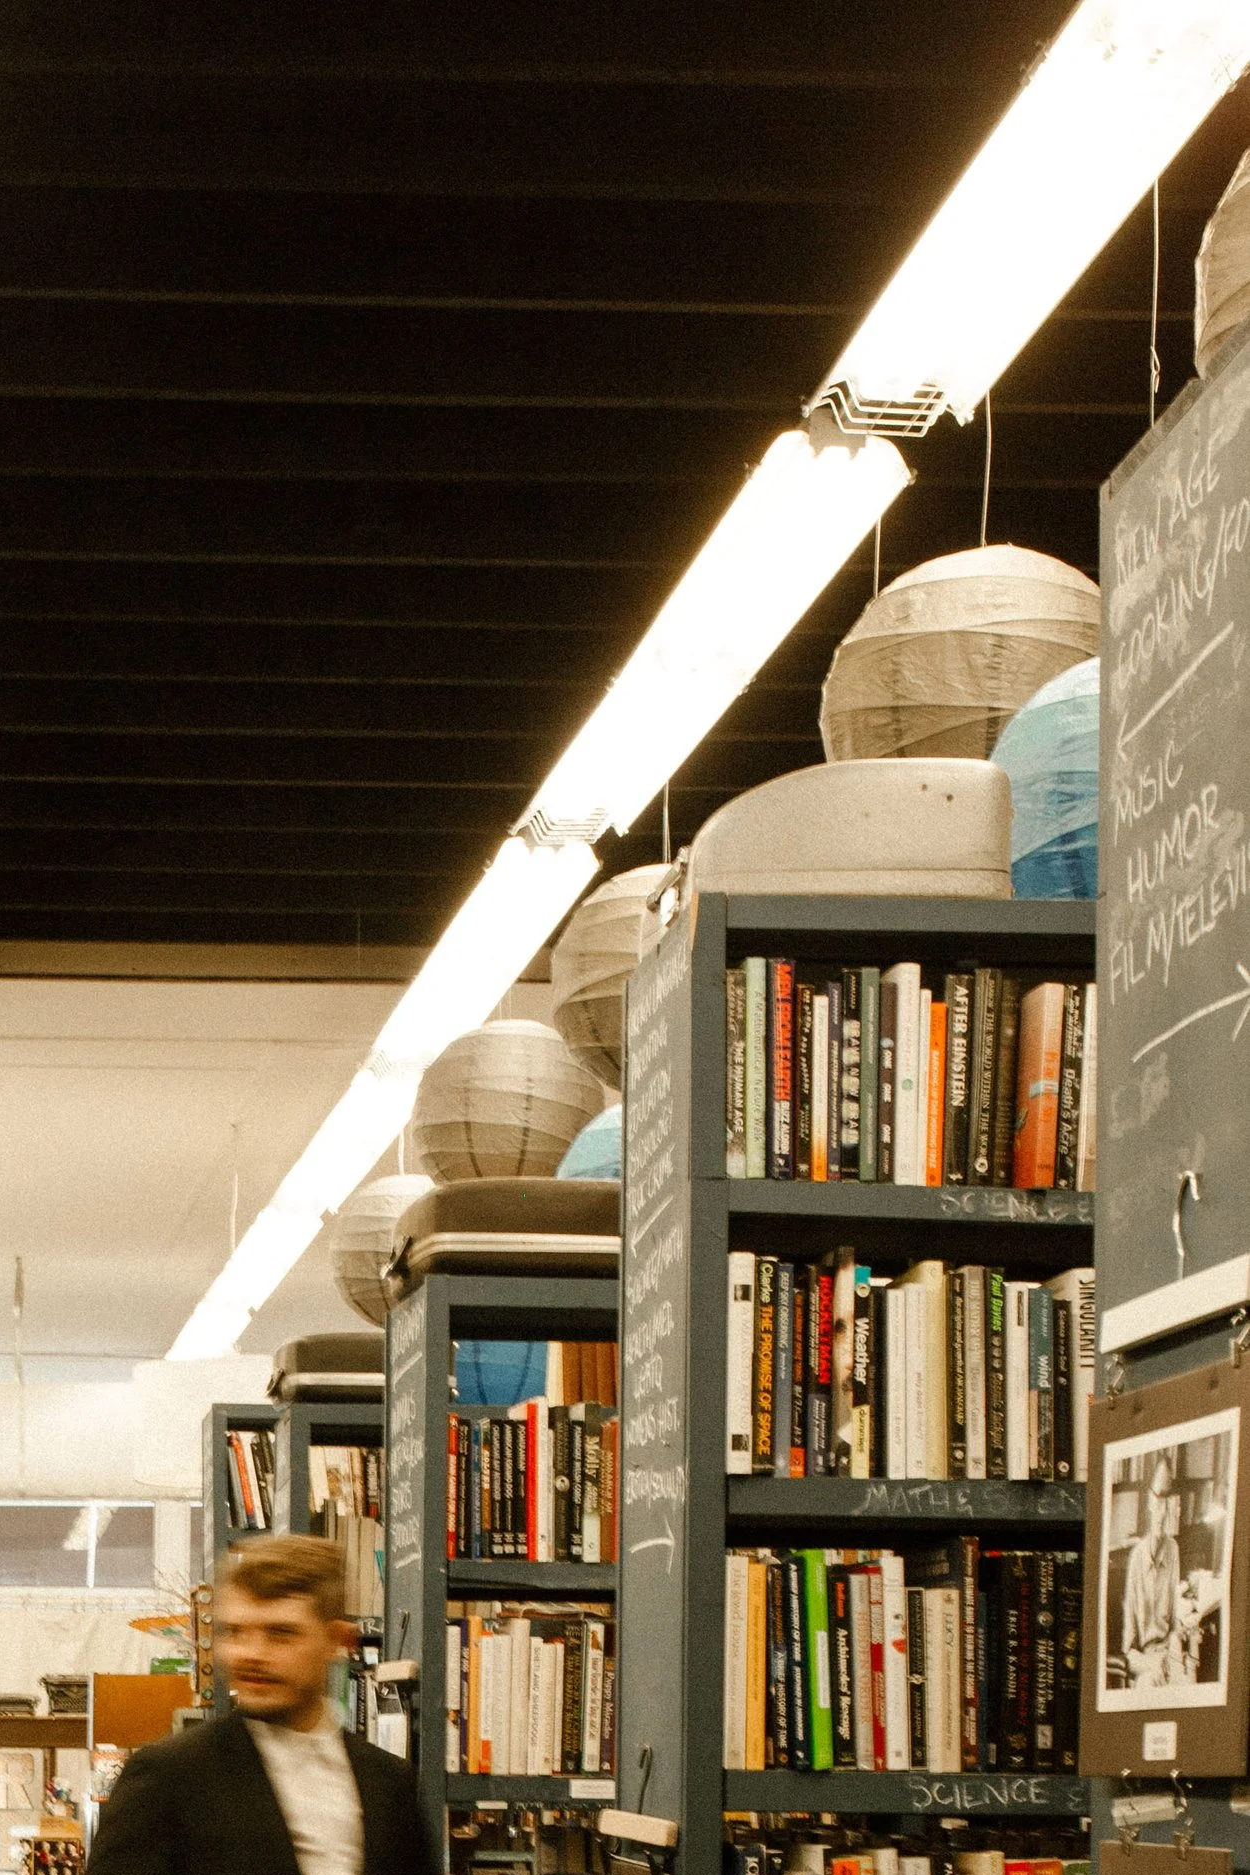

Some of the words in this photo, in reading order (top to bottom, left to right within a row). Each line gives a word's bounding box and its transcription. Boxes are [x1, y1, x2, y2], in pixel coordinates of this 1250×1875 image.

[1169, 425, 1222, 537] AGE
[1114, 740, 1184, 847] MUSIC
[1127, 783, 1220, 903] HUMOR
[1111, 843, 1250, 1006] FILM/TELEVI
[773, 964, 791, 998] MEN
[774, 1002, 791, 1046] FROM
[954, 985, 969, 1033] AFTER
[735, 1041, 744, 1062] THE
[884, 1049, 893, 1069] ONE
[951, 1037, 968, 1106] EINSTEIN
[734, 1065, 744, 1107] HUMAN
[775, 1049, 791, 1100] EARTH
[883, 1083, 892, 1102] ONE
[1061, 1068, 1076, 1118] Death's
[735, 1110, 744, 1133] AGE
[882, 1124, 891, 1143] ONE
[1060, 1122, 1073, 1154] Acre
[760, 1263, 773, 1303] Clarke
[991, 1274, 1003, 1296] Paul
[760, 1305, 773, 1331] THE
[992, 1298, 1003, 1331] Davies
[759, 1333, 772, 1390] PROMISE
[854, 1317, 869, 1383] Weather
[992, 1372, 1004, 1408] Cosmic
[1038, 1355, 1052, 1387] wind
[759, 1392, 772, 1410] OF
[758, 1414, 771, 1455] SPACE
[585, 1435, 599, 1478] Molly
[1006, 1610, 1018, 1635] ERIC
[837, 1628, 850, 1695] Archimedes'
[605, 1671, 615, 1700] Puppy
[839, 1696, 851, 1740] Revenge
[908, 1776, 1049, 1811] SCIENCE
